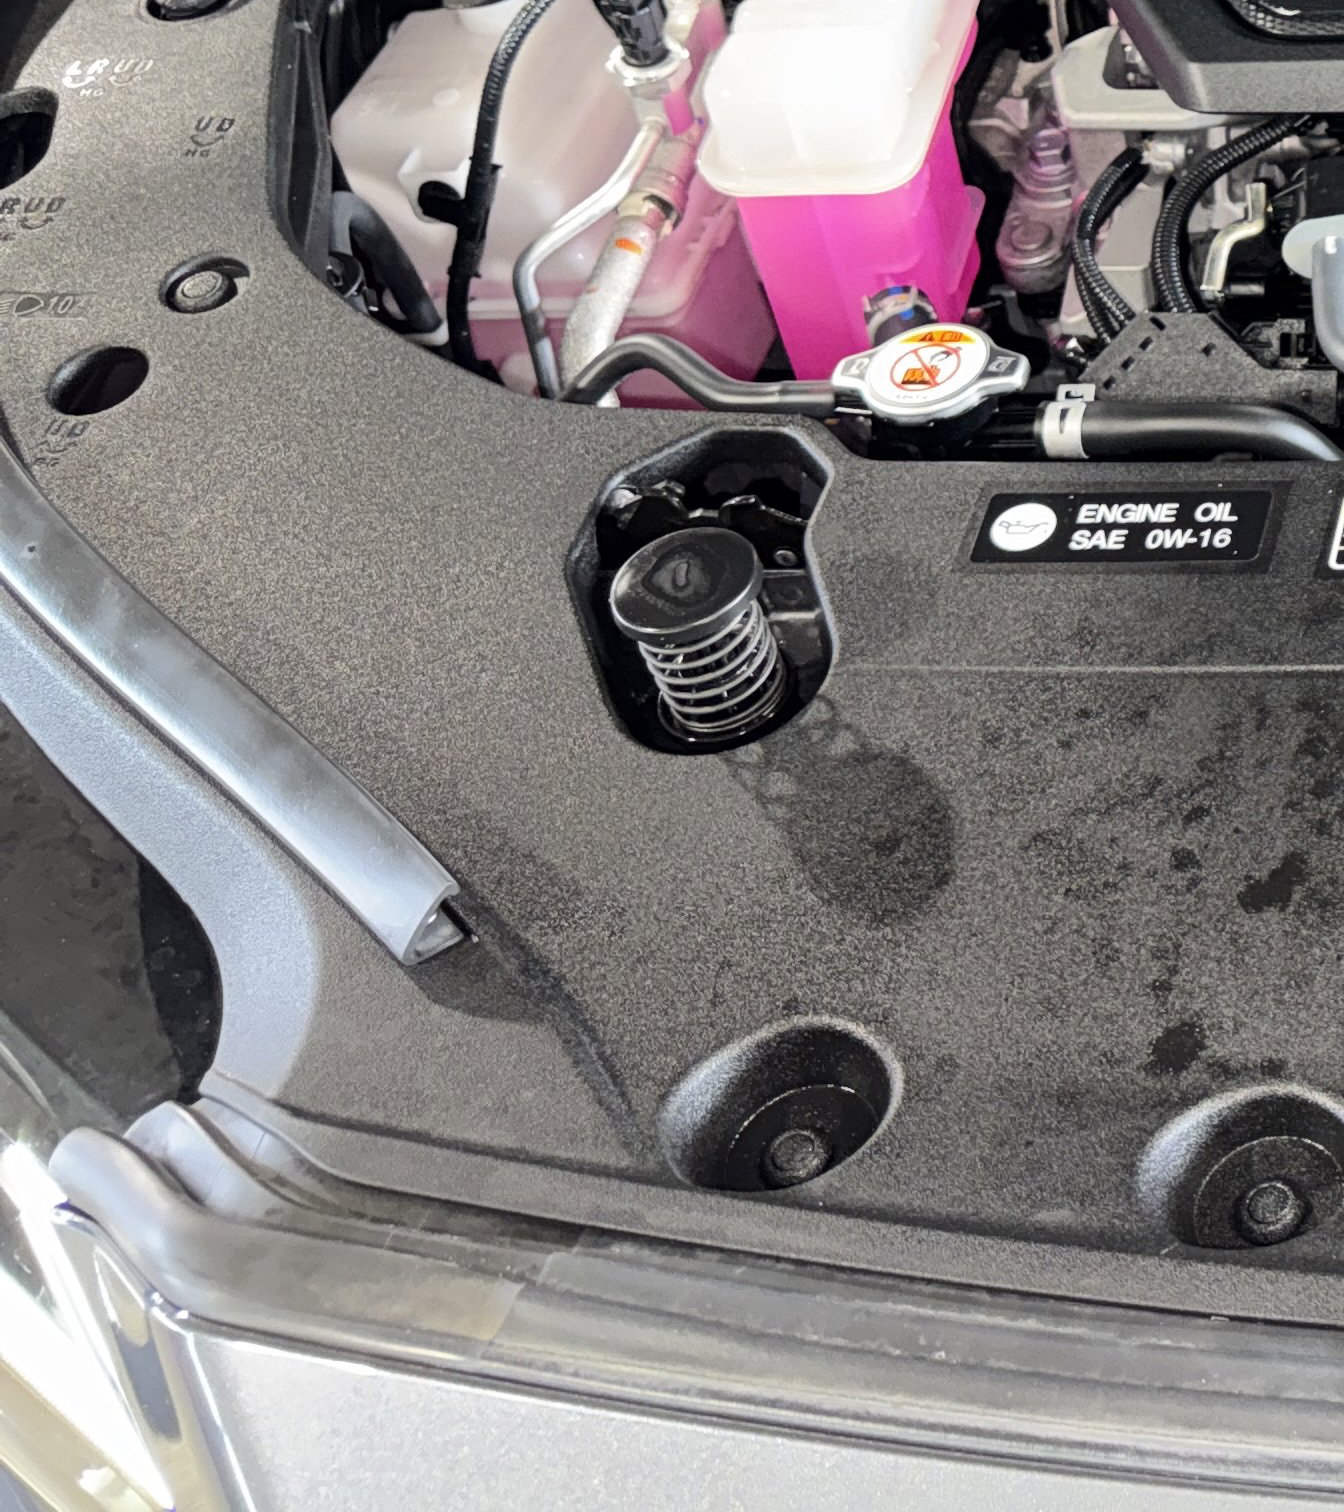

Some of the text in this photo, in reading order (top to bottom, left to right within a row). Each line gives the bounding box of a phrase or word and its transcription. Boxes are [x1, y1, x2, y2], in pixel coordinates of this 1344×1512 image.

[1076, 502, 1239, 524] ENGINE OIL
[1068, 528, 1233, 551] SAE 0W-16
